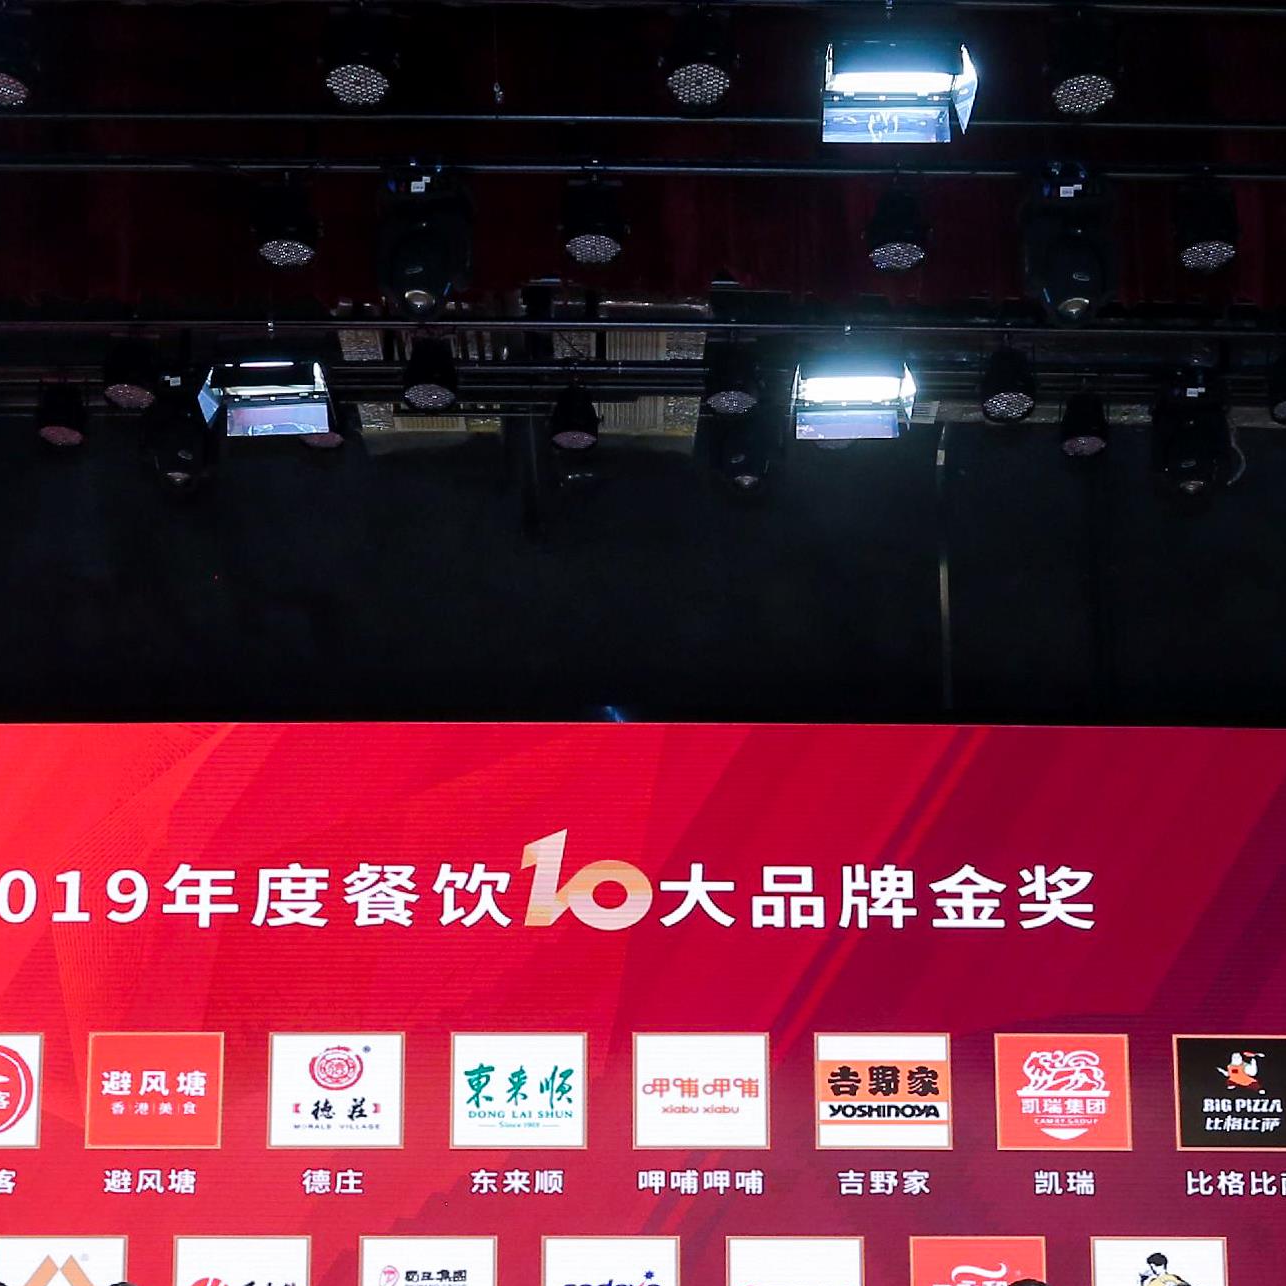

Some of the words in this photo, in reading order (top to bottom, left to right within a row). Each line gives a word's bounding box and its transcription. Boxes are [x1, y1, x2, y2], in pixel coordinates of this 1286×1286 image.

[101, 1070, 207, 1097] 避风塘
[642, 1077, 760, 1098] 呷哺呷哺
[828, 1066, 940, 1096] 吉野家
[468, 1110, 506, 1119] DONG
[511, 1110, 533, 1119] LAI
[537, 1110, 573, 1119] SHUN
[662, 1104, 699, 1114] xiabu
[703, 1104, 739, 1114] xiabu
[829, 1104, 940, 1119] YOSHINOYA
[1021, 1098, 1106, 1115] 凯瑞集团
[1203, 1098, 1232, 1113] BIG
[1235, 1098, 1283, 1113] PIZZA
[1205, 1115, 1281, 1132] 比格比萨
[103, 1169, 197, 1194] 避风塘
[302, 1169, 363, 1194] 德庄
[470, 1169, 564, 1194] 东来顺
[637, 1169, 764, 1195] 呷哺呷哺
[838, 1170, 931, 1195] 吉野家
[1034, 1170, 1095, 1195] 凯瑞
